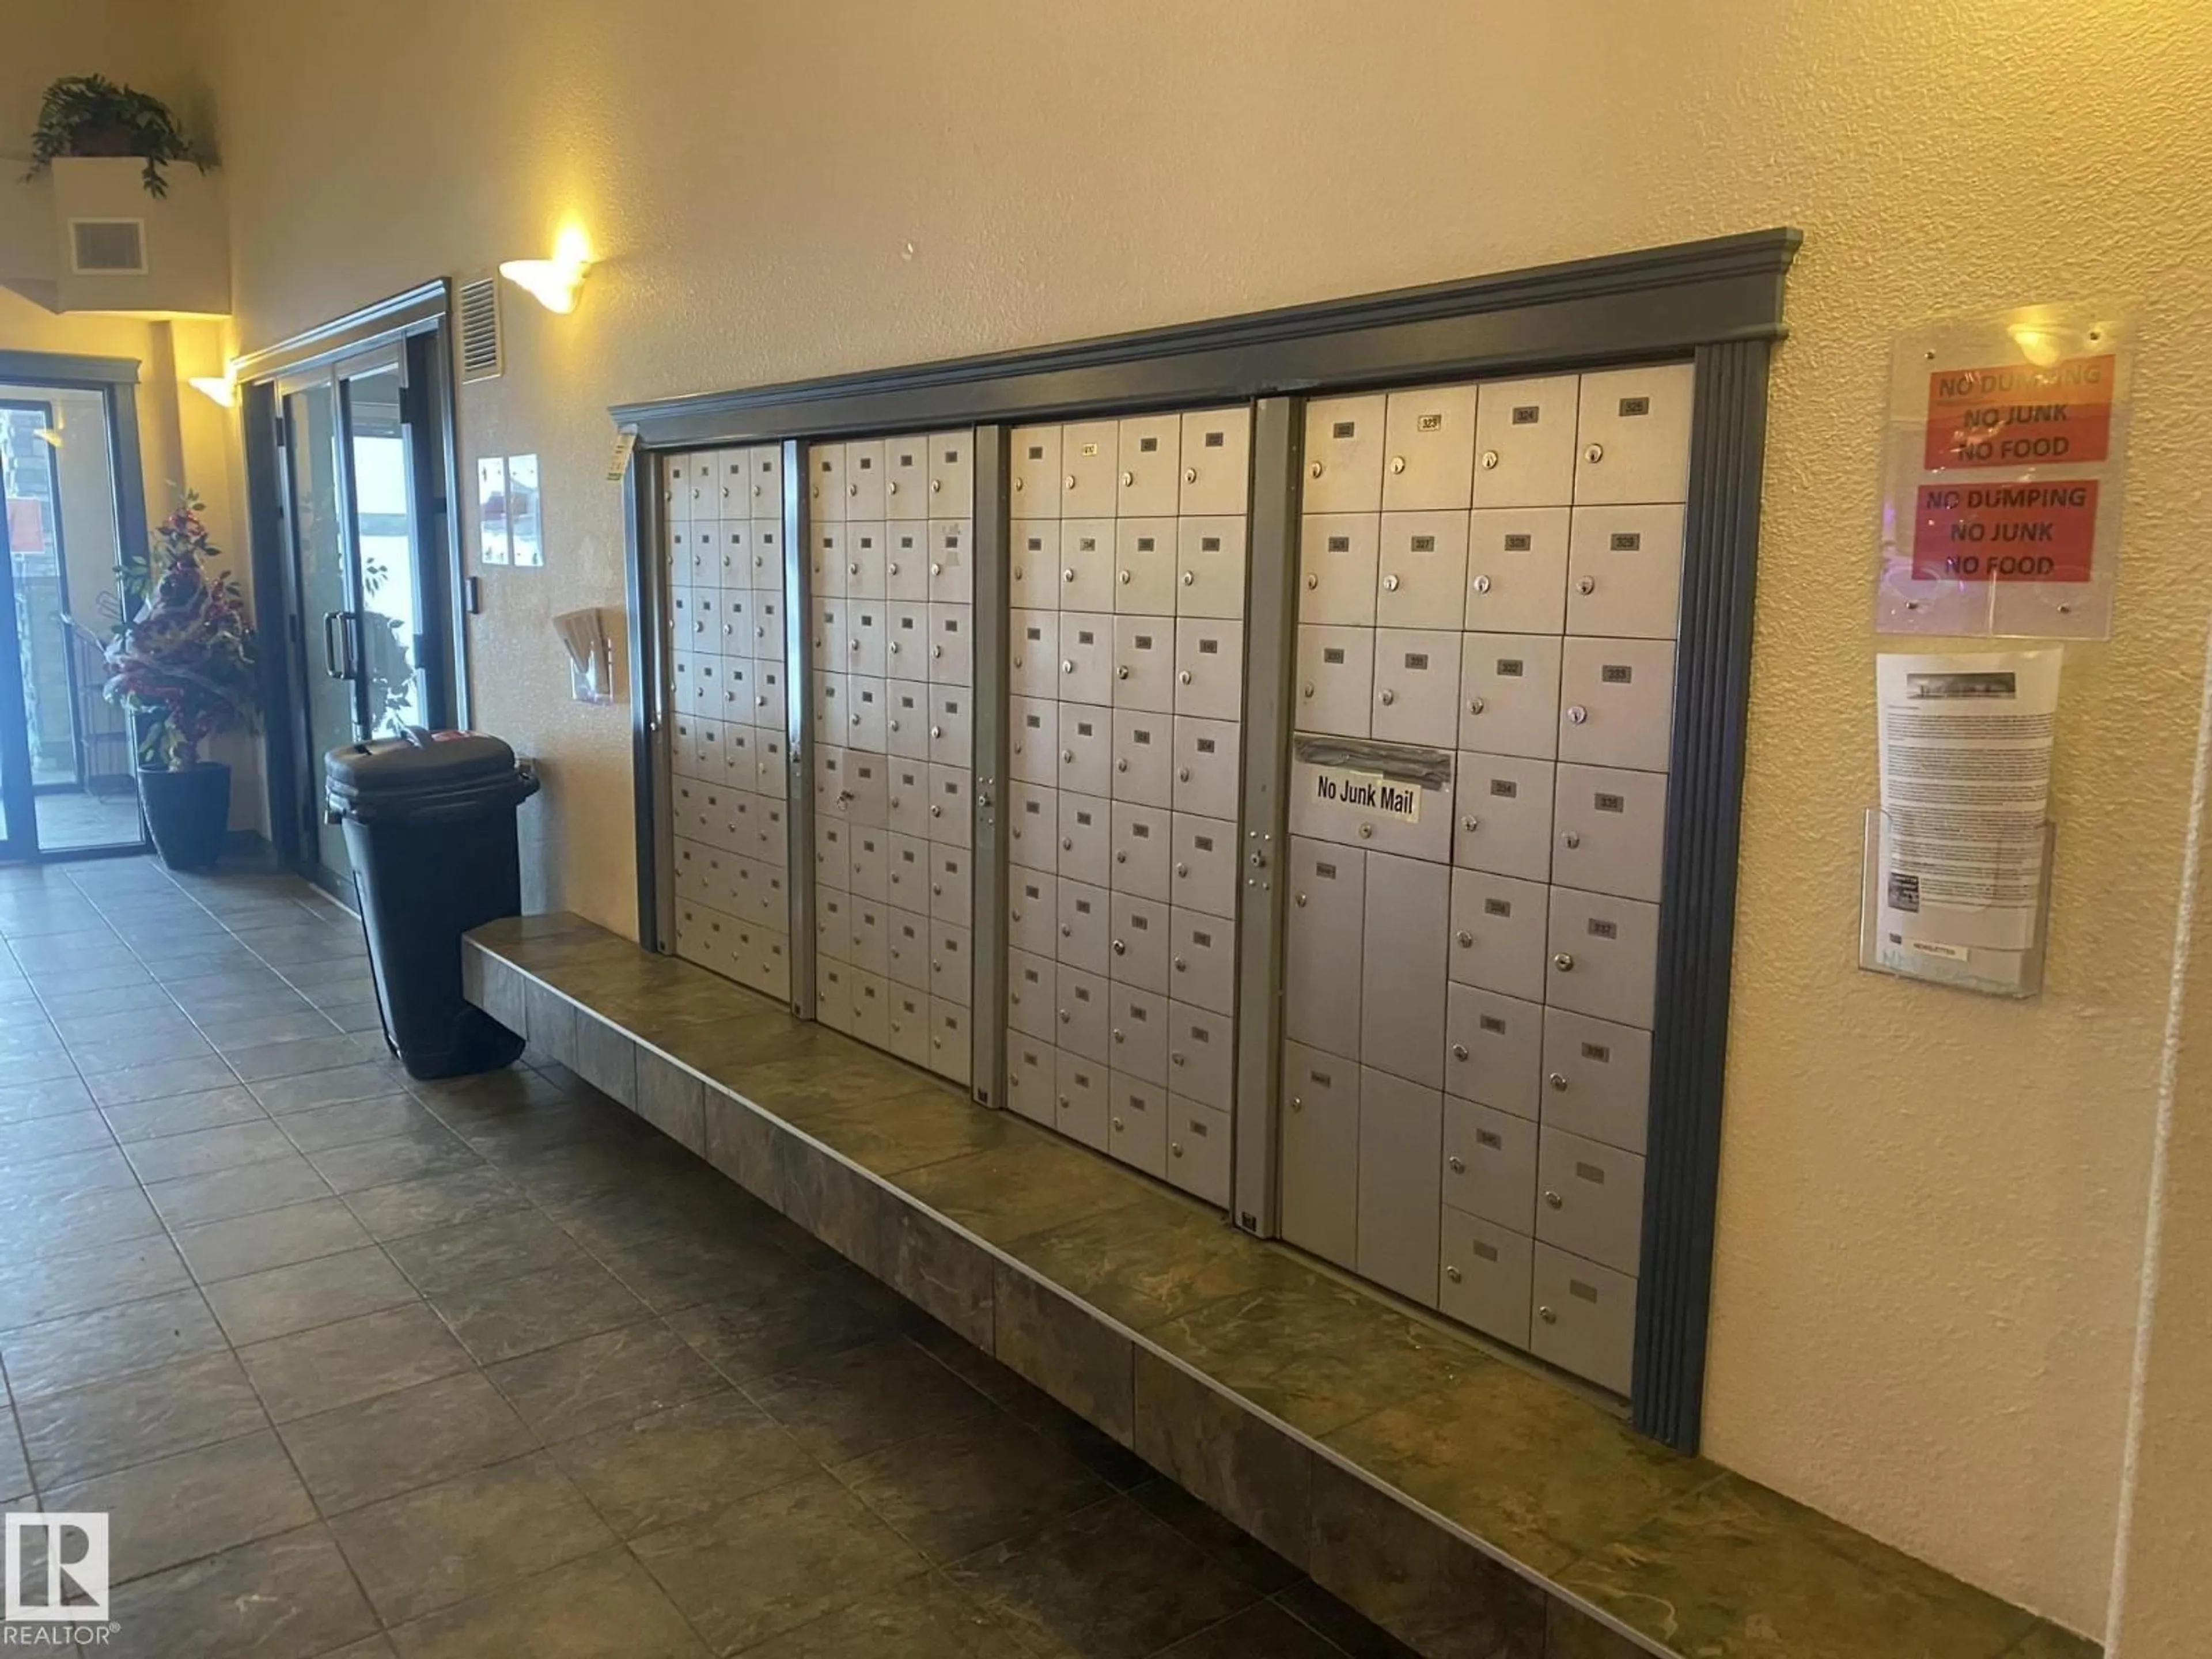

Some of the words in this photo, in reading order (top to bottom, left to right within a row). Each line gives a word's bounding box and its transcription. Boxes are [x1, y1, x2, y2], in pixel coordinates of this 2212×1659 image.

[1939, 377, 1973, 397] NO
[1421, 417, 1440, 429] 323
[1963, 407, 1999, 427] NO
[2006, 404, 2069, 425] JUNK
[1958, 442, 1993, 461] NO
[2001, 436, 2070, 459] FOOD
[1926, 491, 1960, 509] NO
[1967, 487, 2087, 509] DUMPING
[1950, 523, 1985, 541] NO
[1990, 522, 2054, 541] JUNK
[1946, 556, 1979, 575] NO
[1986, 556, 2055, 575] FOOD
[1318, 775, 1336, 799] No
[1340, 779, 1376, 808] Junk
[1380, 786, 1414, 815] Mail
